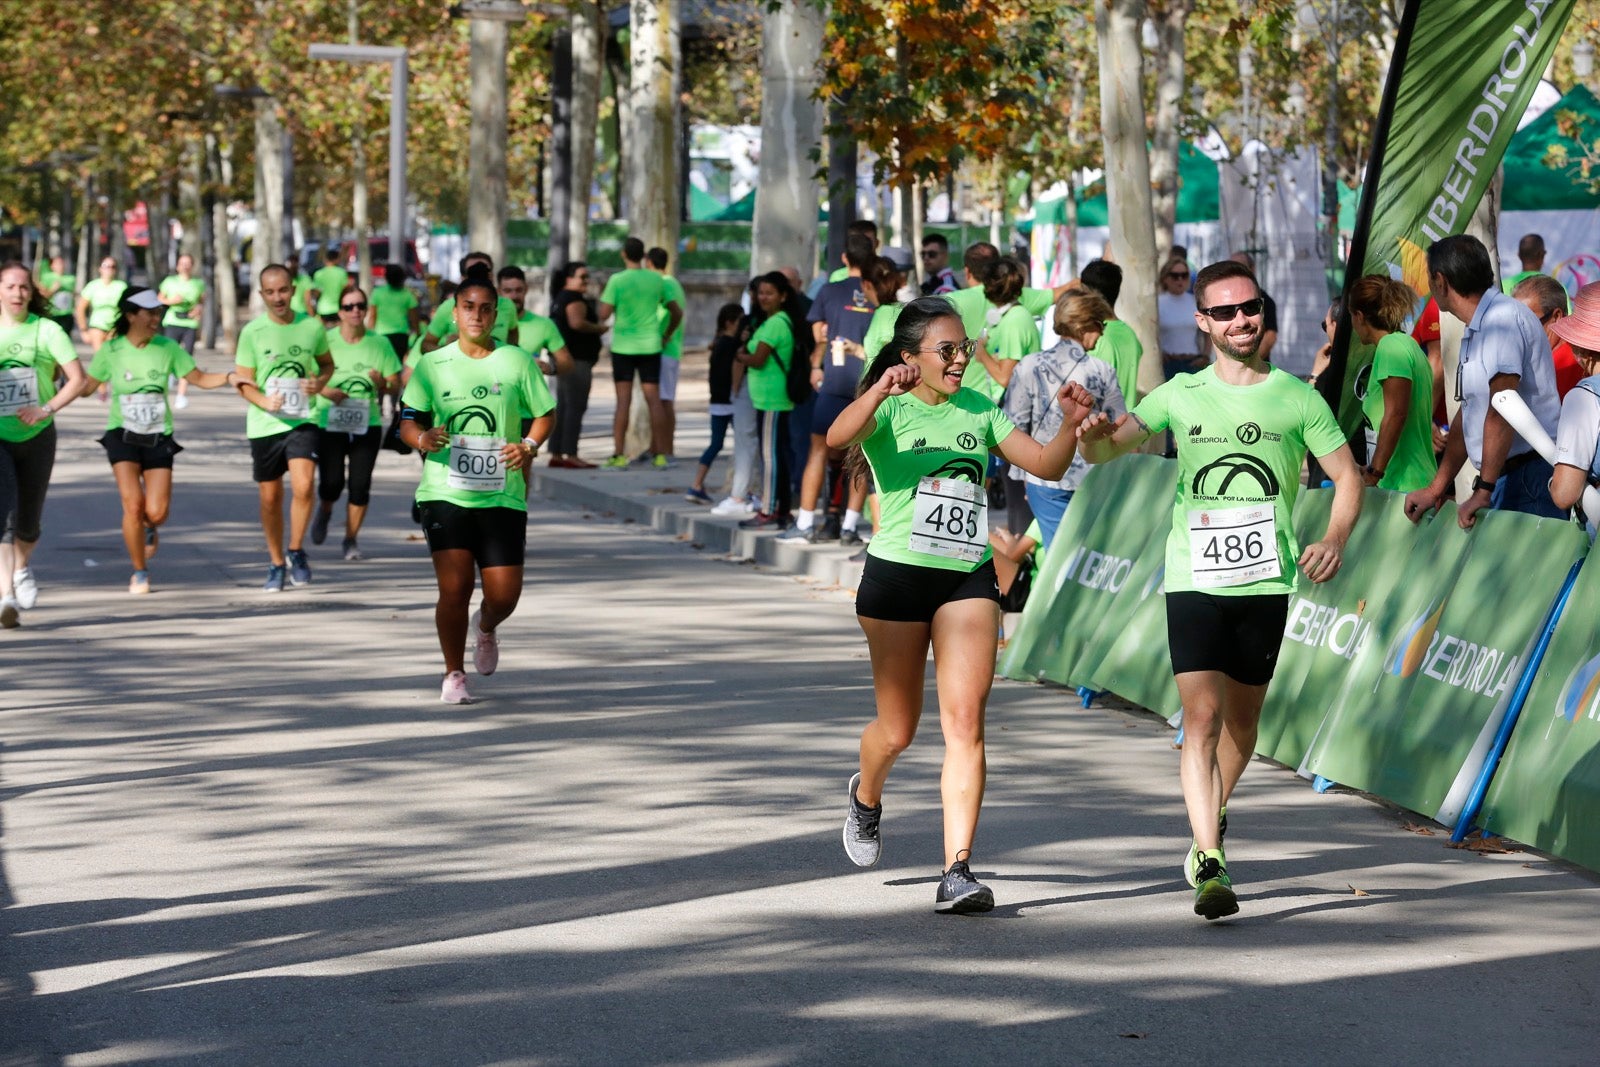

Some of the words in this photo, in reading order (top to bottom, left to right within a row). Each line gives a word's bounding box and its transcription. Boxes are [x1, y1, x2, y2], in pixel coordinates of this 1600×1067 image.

[1420, 0, 1553, 242] IBERDROLA
[457, 453, 497, 475] 609
[925, 504, 977, 538] 485
[1203, 531, 1263, 564] 486
